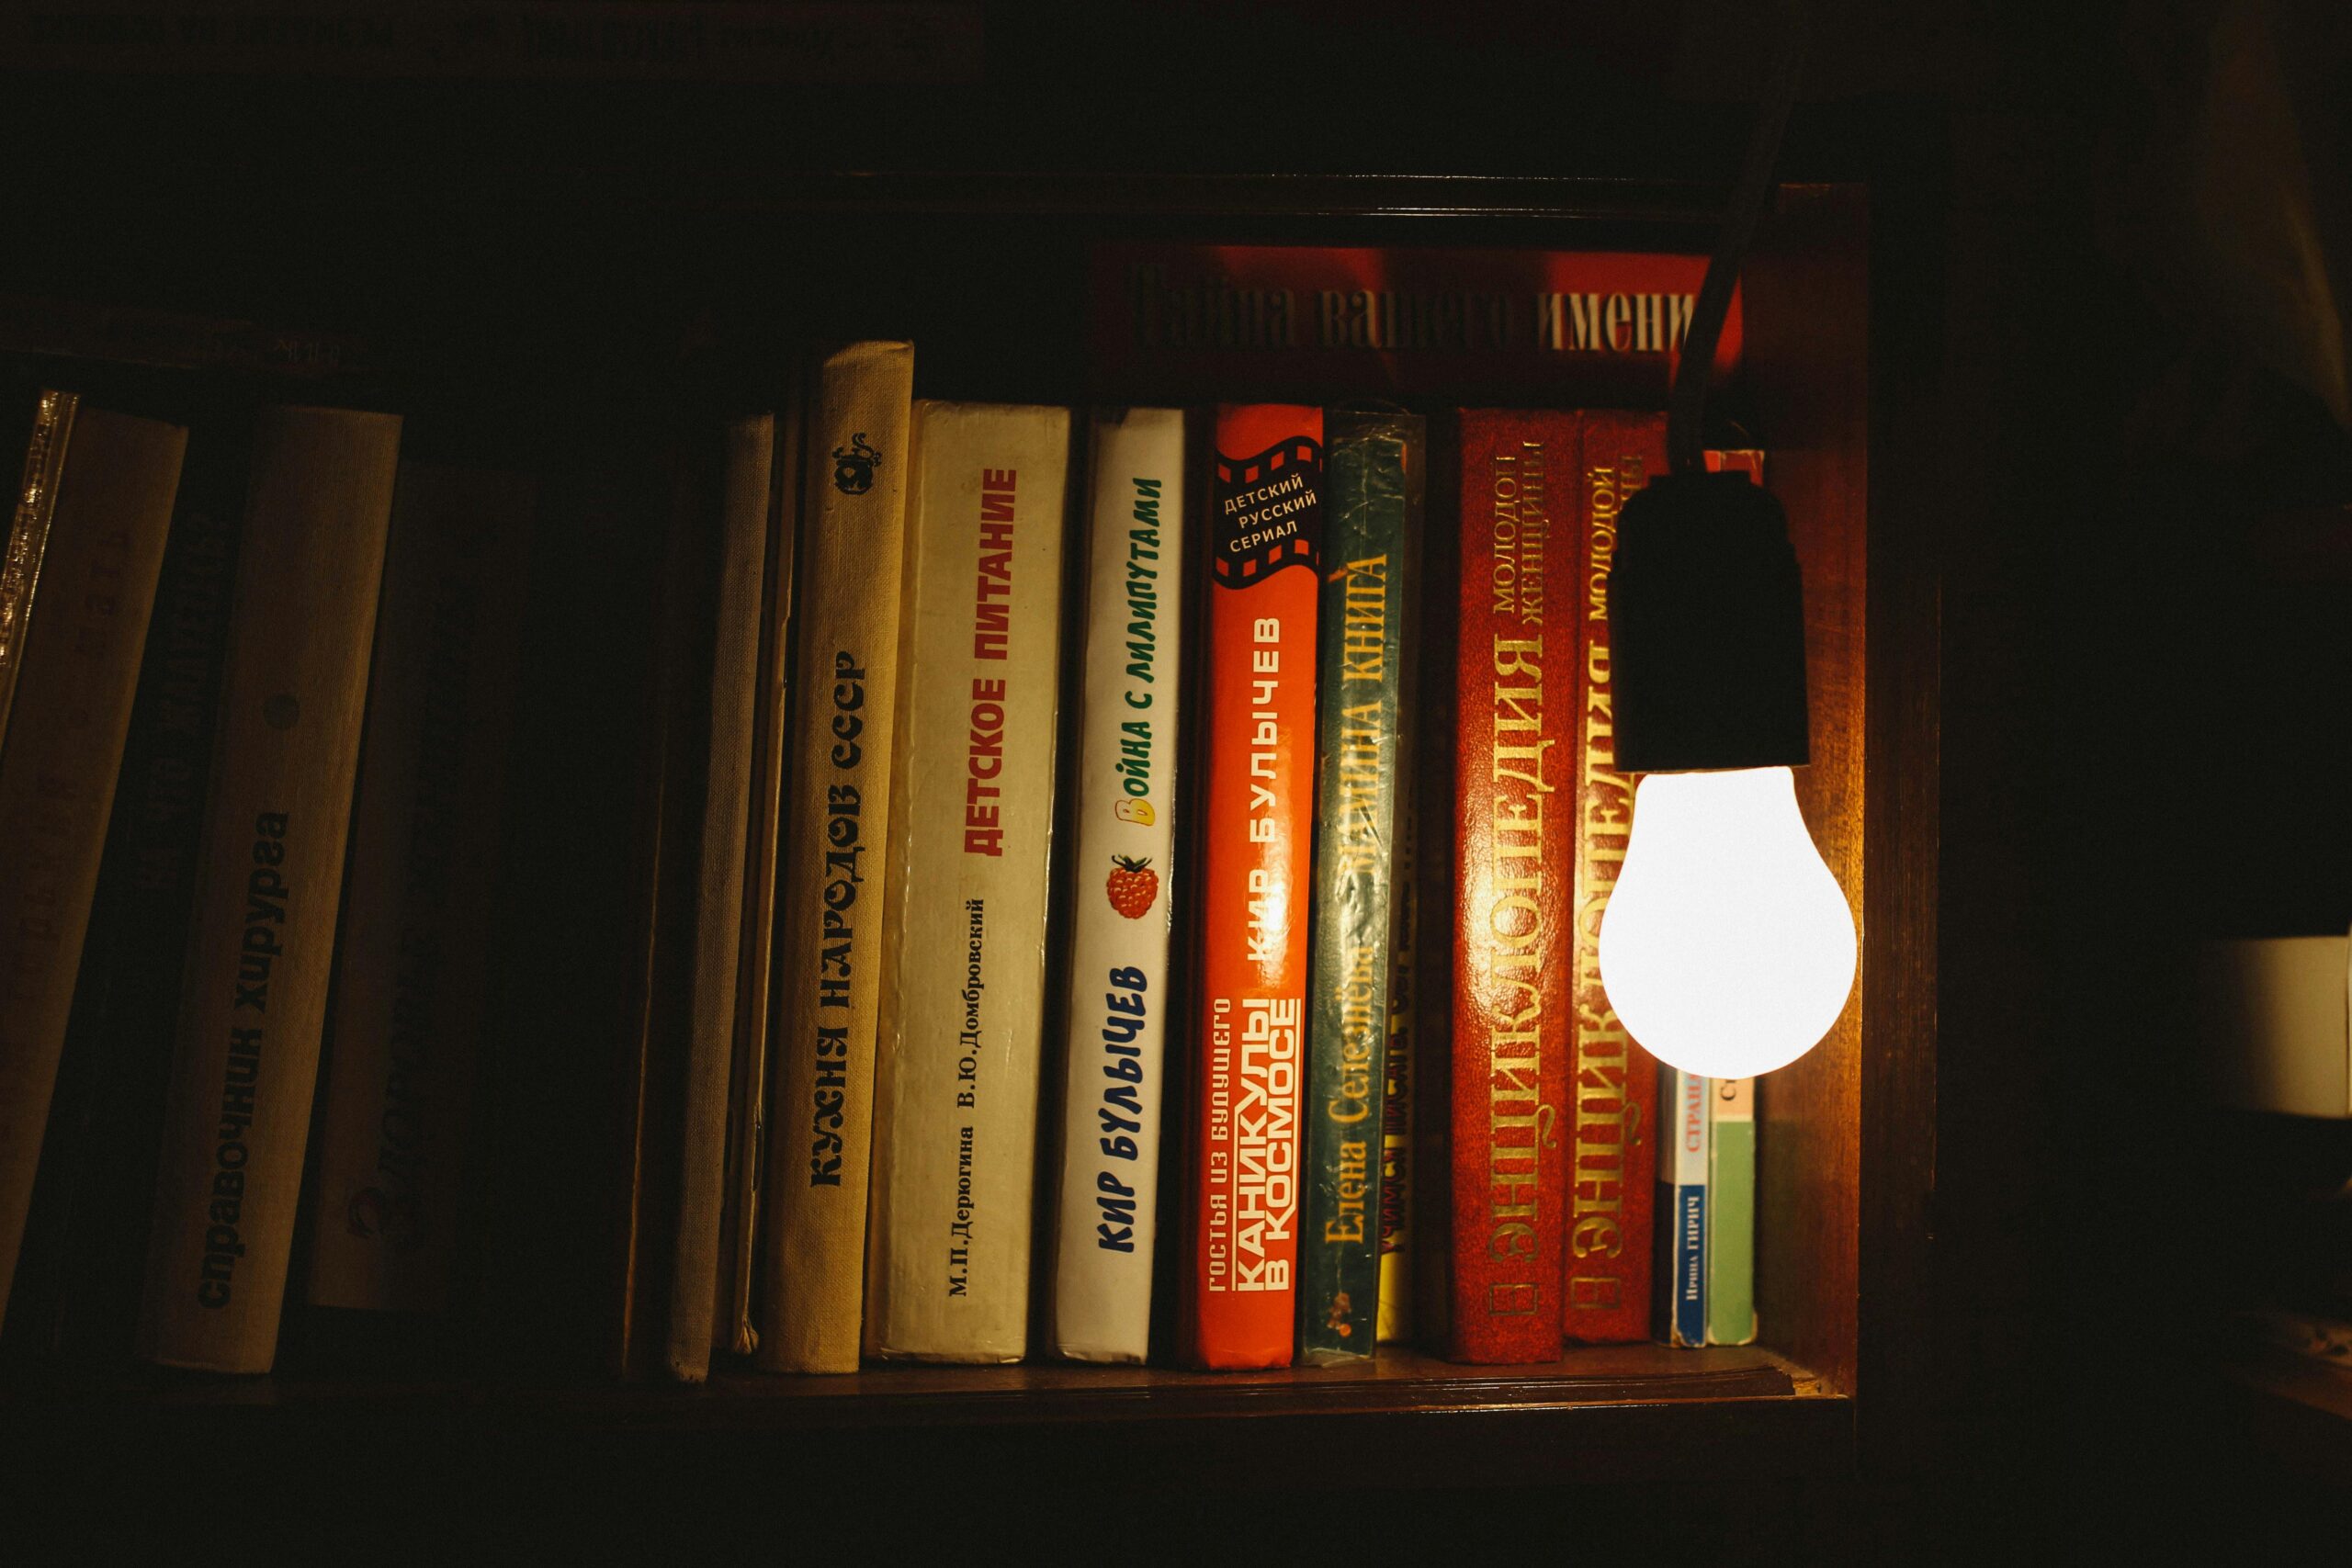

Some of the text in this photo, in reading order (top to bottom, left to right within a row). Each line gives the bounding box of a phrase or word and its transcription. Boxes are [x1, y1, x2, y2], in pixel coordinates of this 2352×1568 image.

[1319, 287, 1516, 352] вашего
[1536, 290, 1696, 353] имени
[1125, 477, 1162, 683] ЛИЛИПУТАМИ
[1224, 472, 1305, 515] ДЕТСКИЙ
[1229, 520, 1298, 553] СЕРИАЛ
[1238, 489, 1317, 529] РУССКИЙ
[1341, 553, 1387, 682] КНИГА
[1587, 466, 1617, 621] МОЛОДОЙ
[964, 468, 1017, 857] ДЕТСКОЕ ПИТАНИЕ
[1247, 616, 1281, 962] КИР БУЛЫЧЕВ
[196, 810, 290, 1310] справочник хирурга
[809, 650, 865, 1188] КУХНЯ НАРОДОВ СССР
[1487, 633, 1556, 1262] ЭНЦИКЛОПЕДИЯ
[948, 897, 985, 1297] М.П.Дерюгина В.Ю.Домбровский
[1096, 964, 1148, 1254] КИР БУЛЫЧЕВ
[1208, 998, 1232, 1292] ГОСТЬЯ ИЗ БУДУЩЕГО
[1237, 998, 1271, 1292] КАНИКУЛЫ
[1264, 998, 1295, 1291] В КОСМОСЕ
[1324, 1141, 1368, 1245] Елена
